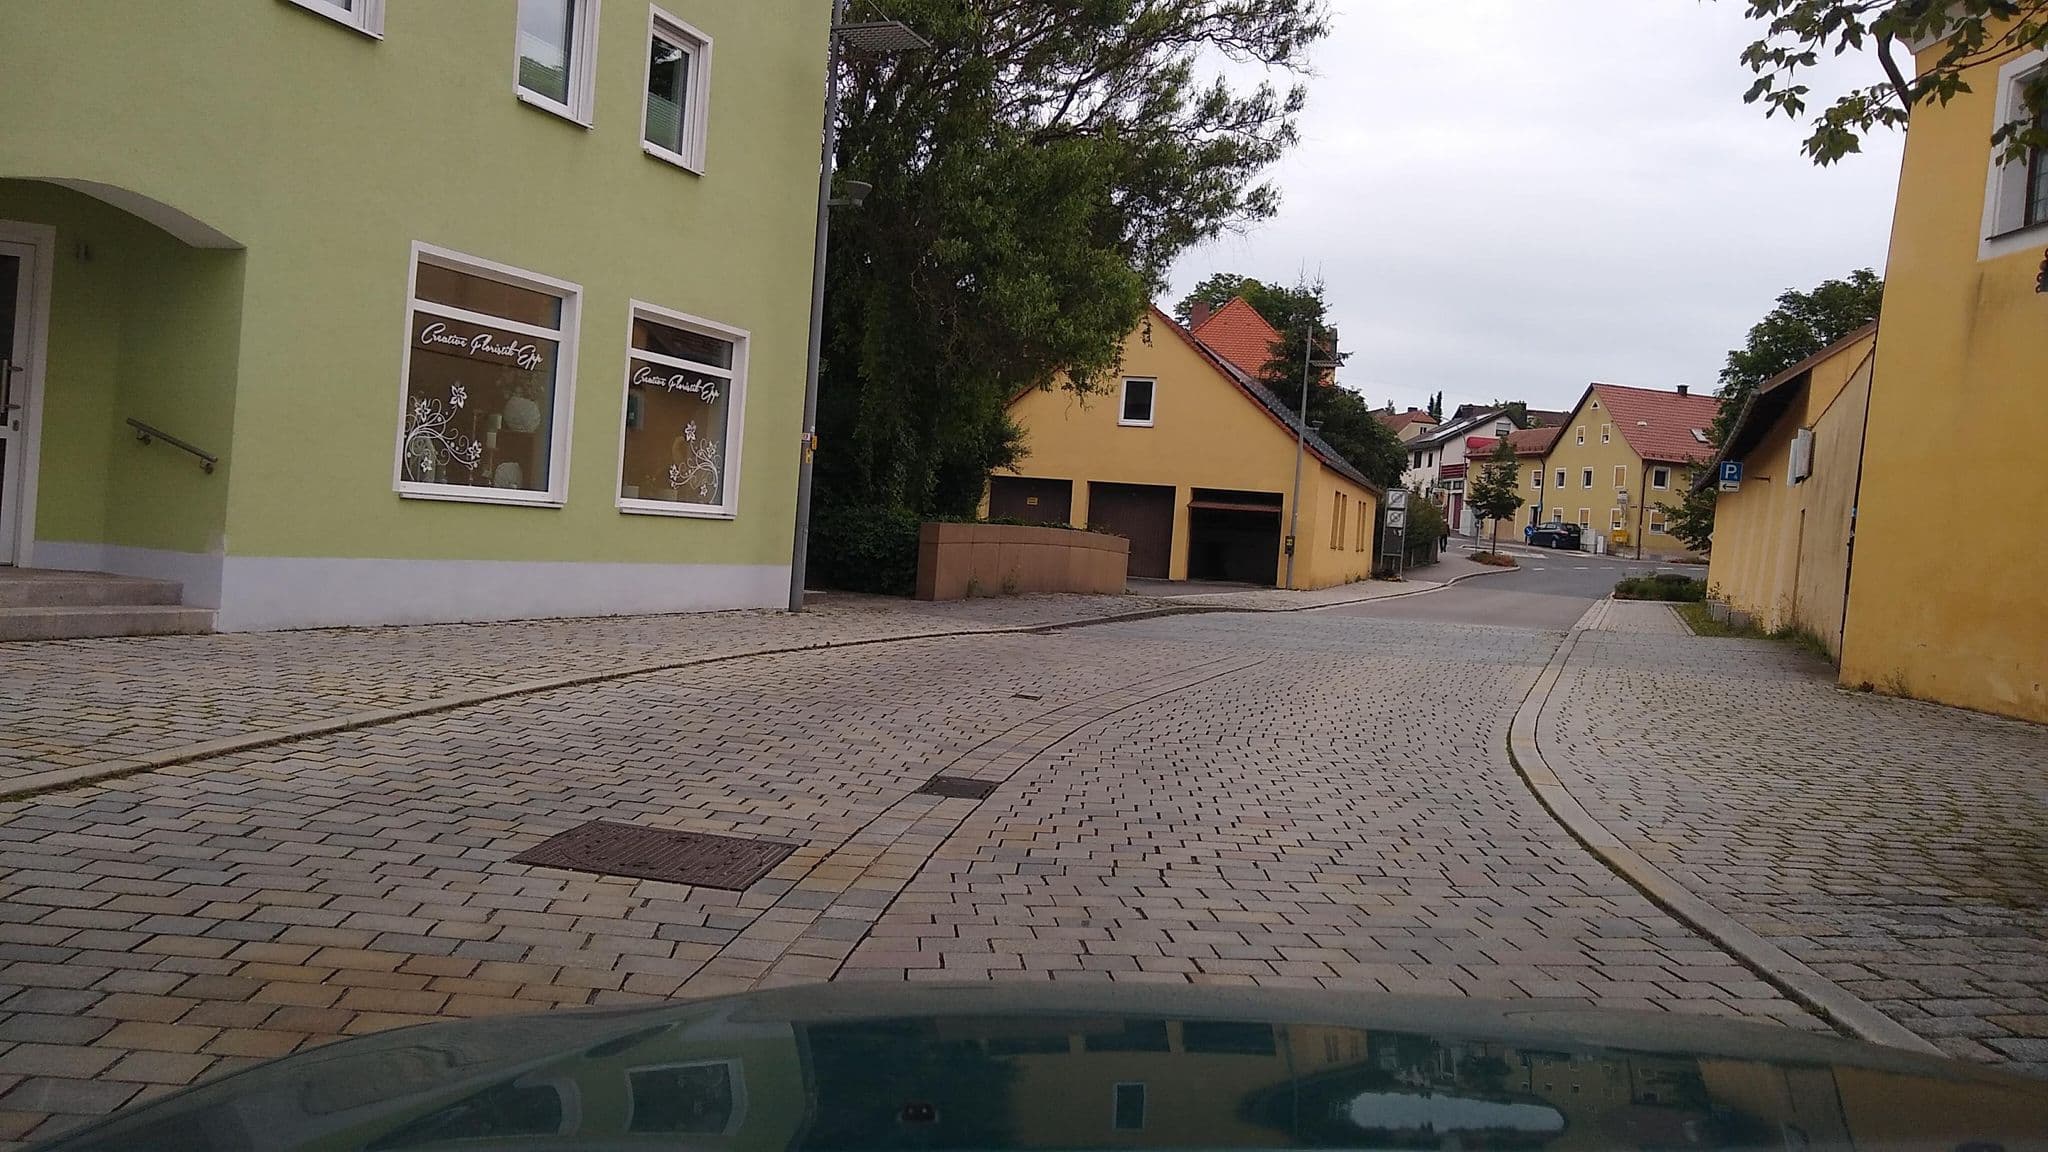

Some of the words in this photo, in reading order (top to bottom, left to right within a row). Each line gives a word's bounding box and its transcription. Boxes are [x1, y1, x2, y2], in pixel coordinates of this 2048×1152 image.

[421, 322, 468, 347] Creative
[633, 366, 667, 386] Creative
[1725, 464, 1737, 479] P
